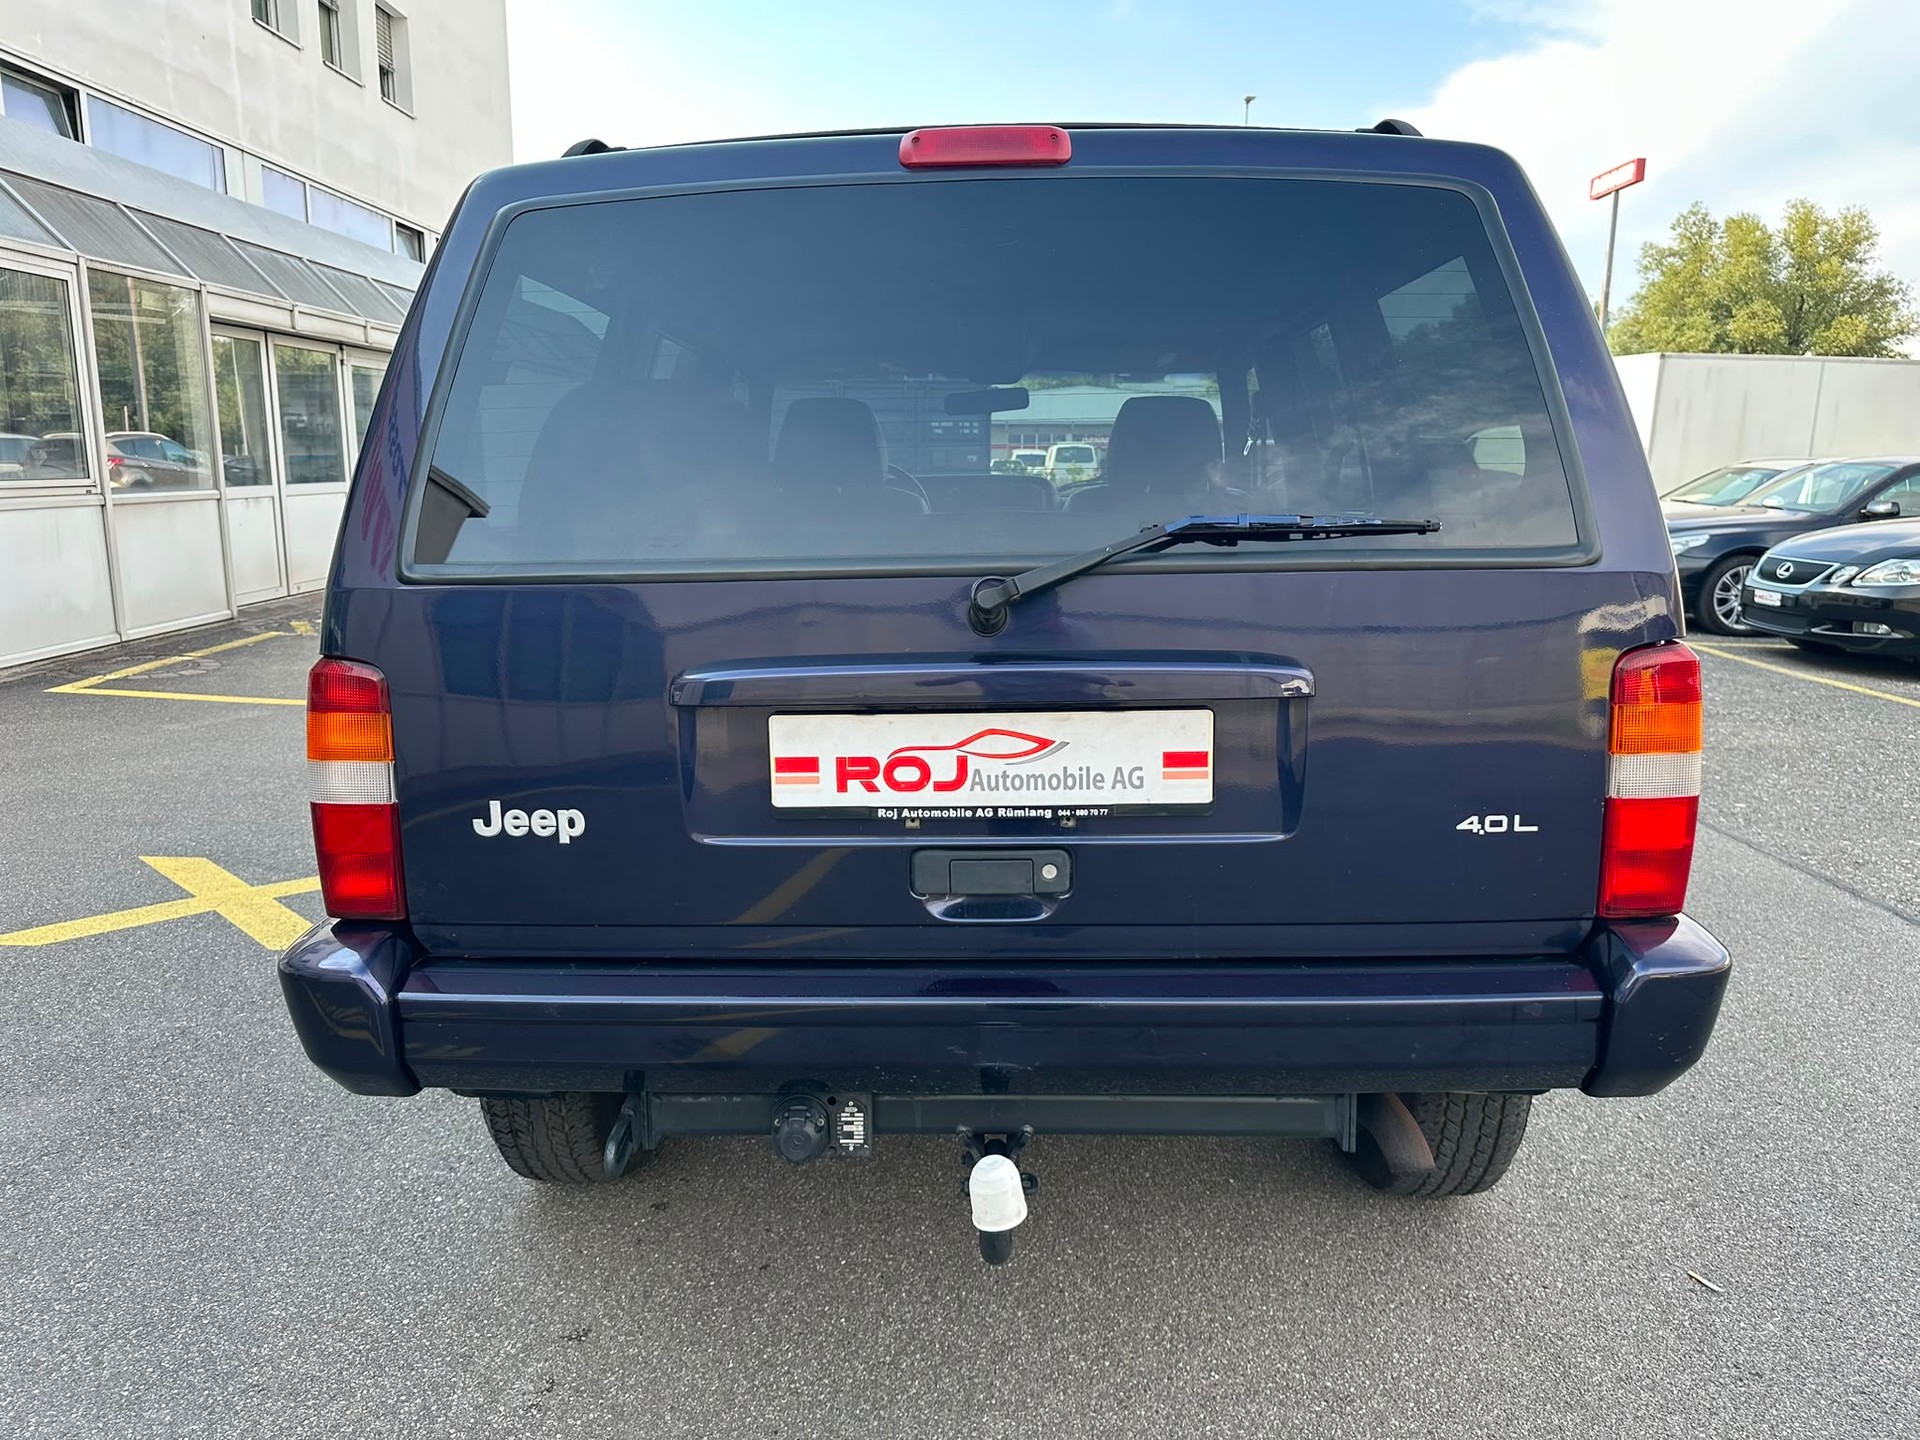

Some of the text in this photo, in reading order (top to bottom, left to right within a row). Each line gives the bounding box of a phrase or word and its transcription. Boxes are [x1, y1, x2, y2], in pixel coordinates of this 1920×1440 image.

[835, 755, 968, 793] ROJ
[969, 765, 1144, 791] Automobile AG
[472, 800, 585, 844] Jeep
[877, 808, 898, 819] Roj
[901, 808, 973, 818] Automobile
[975, 808, 994, 818] AG
[997, 807, 1052, 818] Rümlang
